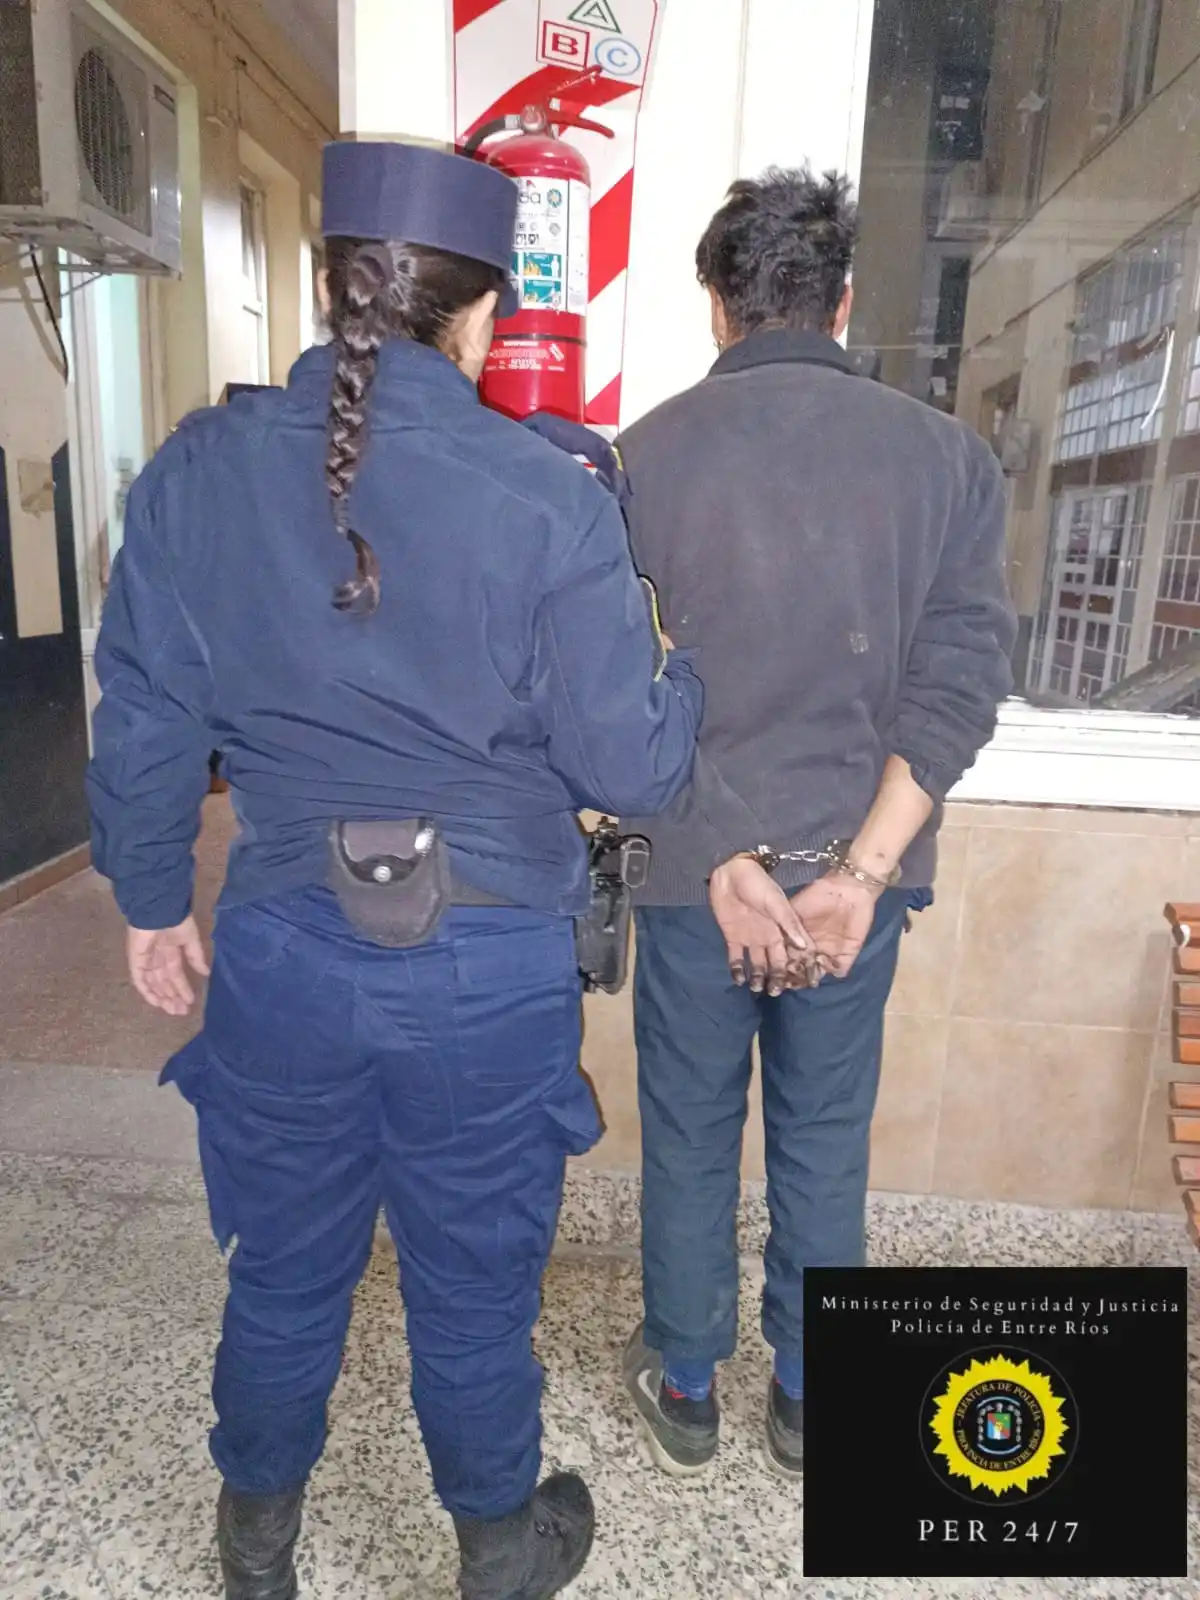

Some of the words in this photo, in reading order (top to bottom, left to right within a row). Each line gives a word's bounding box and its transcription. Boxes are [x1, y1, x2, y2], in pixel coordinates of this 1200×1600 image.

[583, 2, 609, 24] A
[552, 32, 578, 55] B
[607, 47, 628, 67] C
